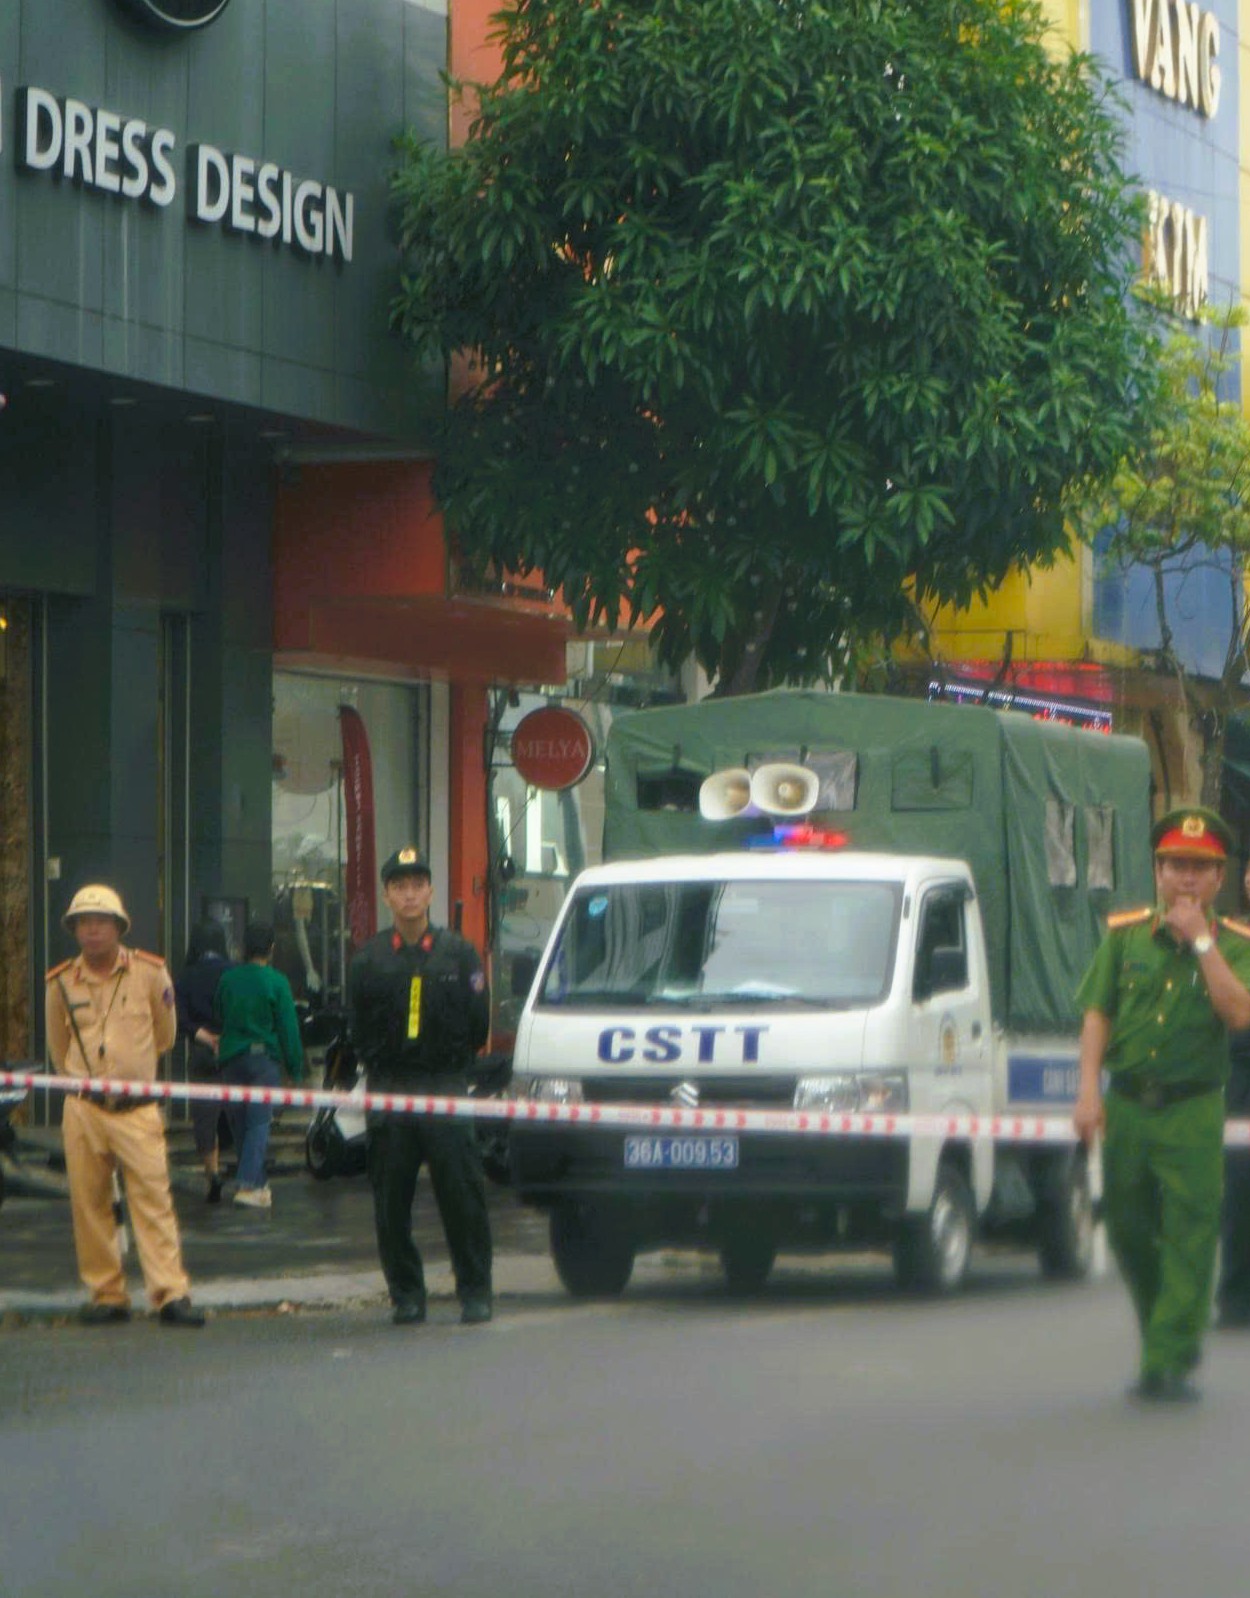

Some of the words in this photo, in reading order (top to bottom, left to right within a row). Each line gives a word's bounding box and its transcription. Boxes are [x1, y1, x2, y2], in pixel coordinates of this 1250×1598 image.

[26, 86, 176, 206] DRESS
[197, 144, 354, 262] DESIGN
[517, 739, 586, 760] MELYA
[597, 1025, 770, 1064] CSTT
